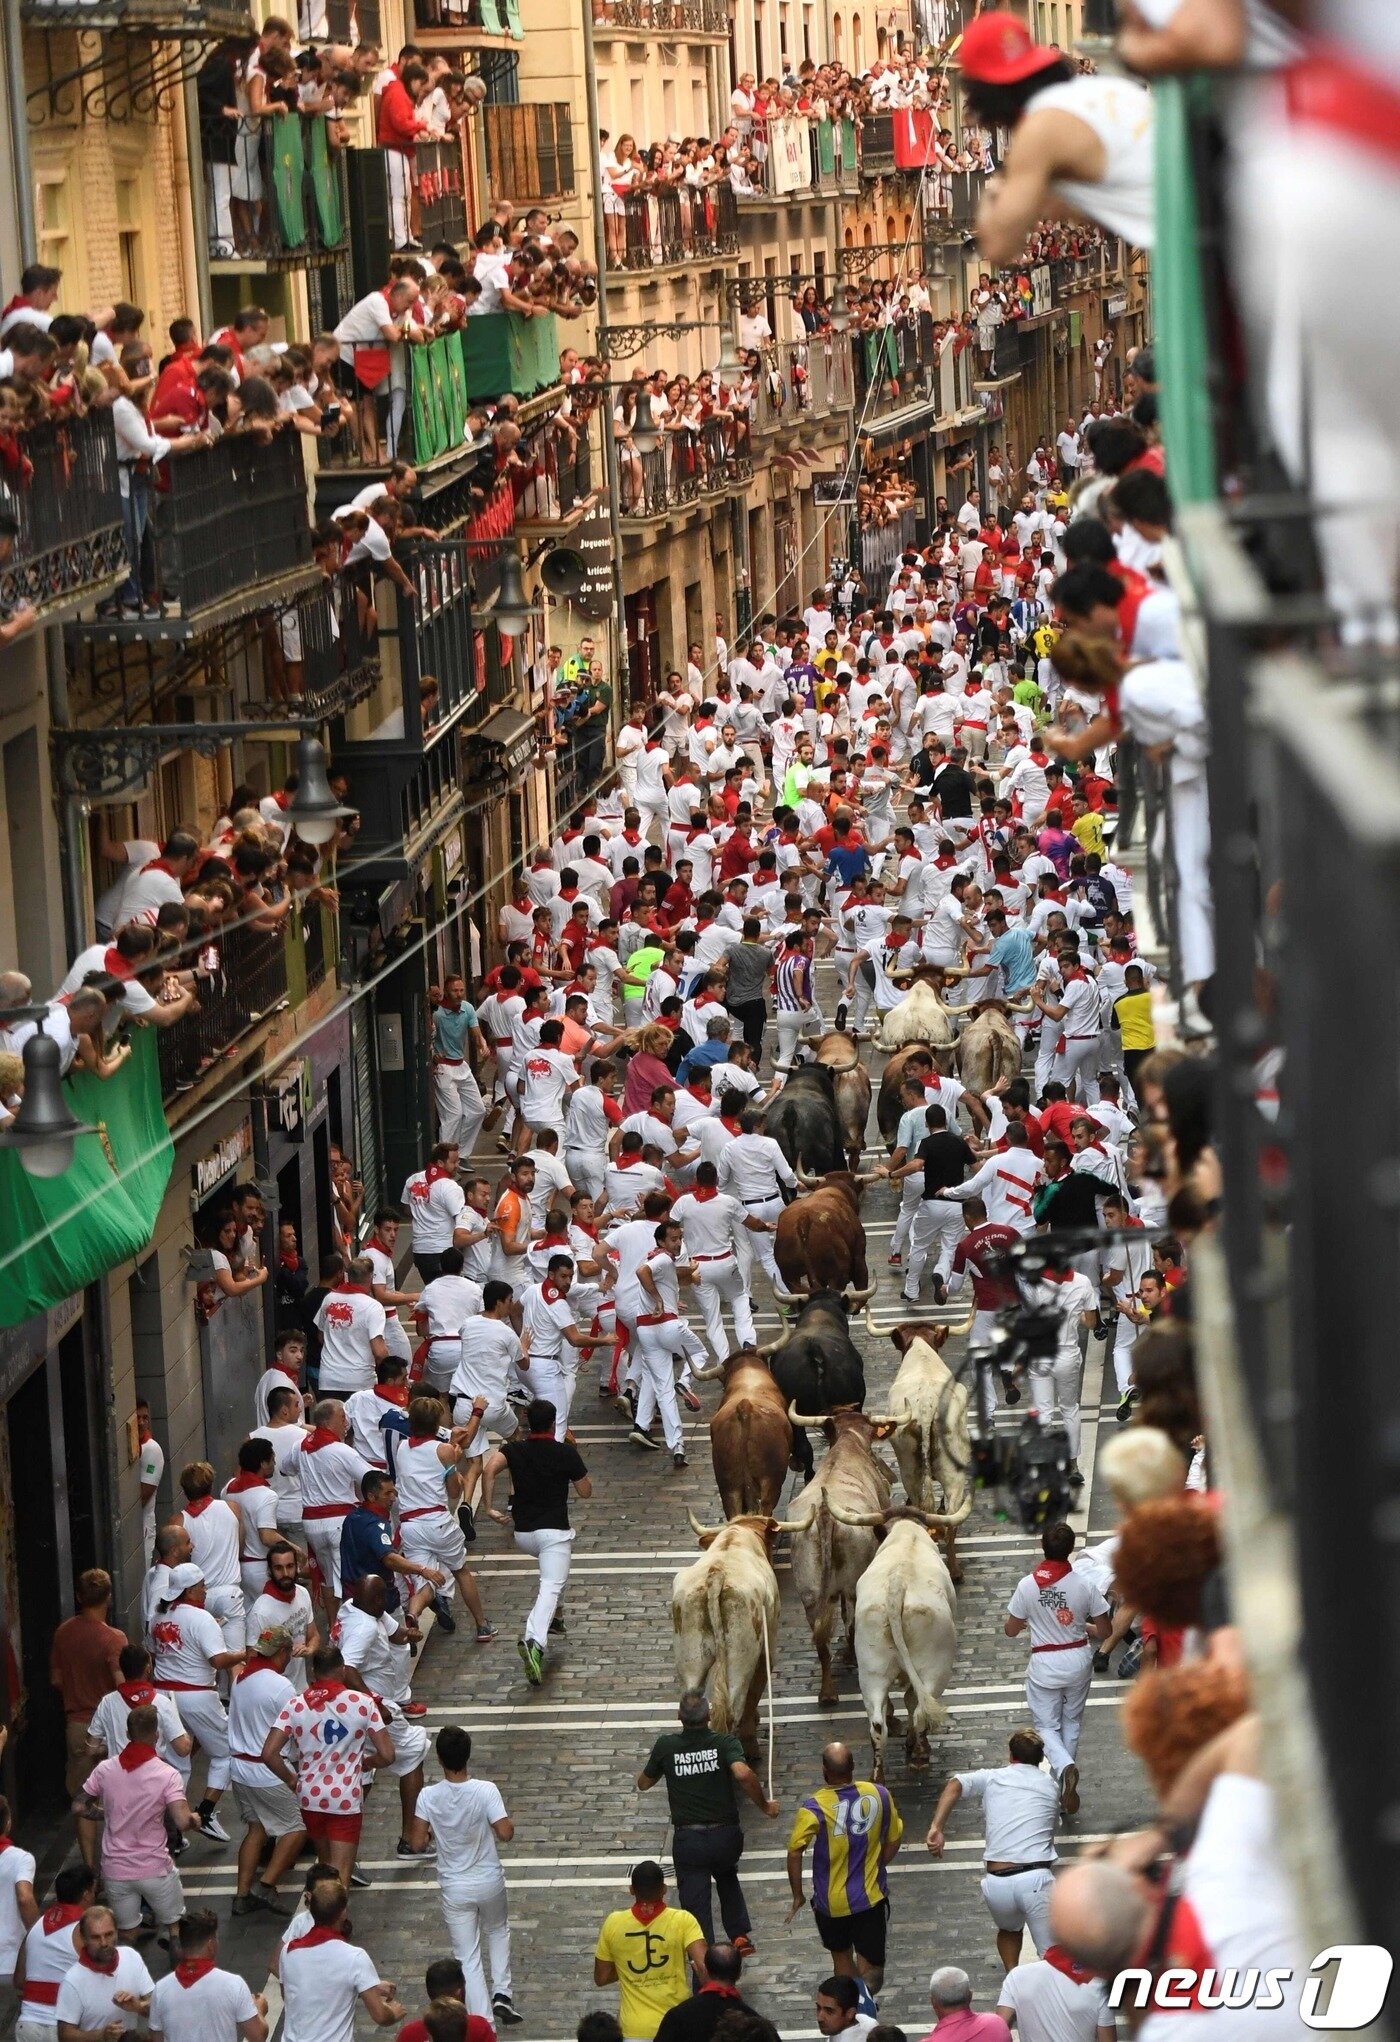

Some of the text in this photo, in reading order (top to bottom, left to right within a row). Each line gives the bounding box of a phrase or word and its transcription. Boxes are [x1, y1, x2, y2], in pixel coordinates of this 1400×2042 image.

[580, 581, 593, 593] de
[786, 674, 811, 696] 34
[673, 1748, 718, 1765] PASTORES
[674, 1759, 720, 1777] UNAIAK
[832, 1795, 879, 1837] 19
